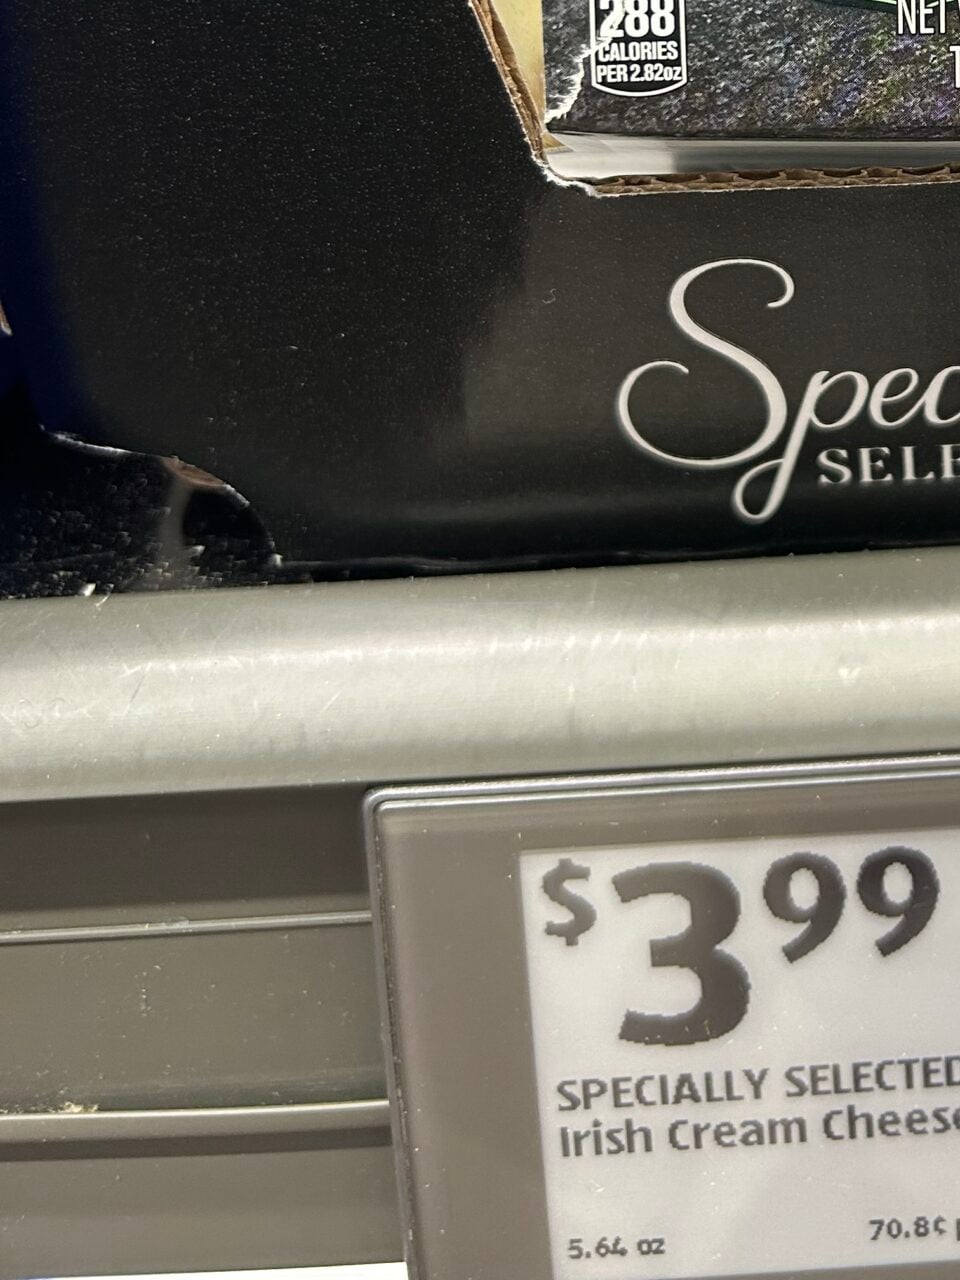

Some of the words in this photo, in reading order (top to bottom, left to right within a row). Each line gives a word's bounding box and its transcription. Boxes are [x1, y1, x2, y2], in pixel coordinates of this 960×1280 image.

[598, 40, 679, 62] CALORIES
[597, 63, 628, 83] PER
[629, 62, 682, 82] 2.82oz
[557, 1068, 770, 1111] SPECIALLY
[560, 1120, 653, 1157] Irish
[668, 1114, 807, 1150] Cream
[869, 1214, 948, 1241] 70.8¢
[568, 1236, 628, 1260] 5.64
[636, 1237, 666, 1255] oz
